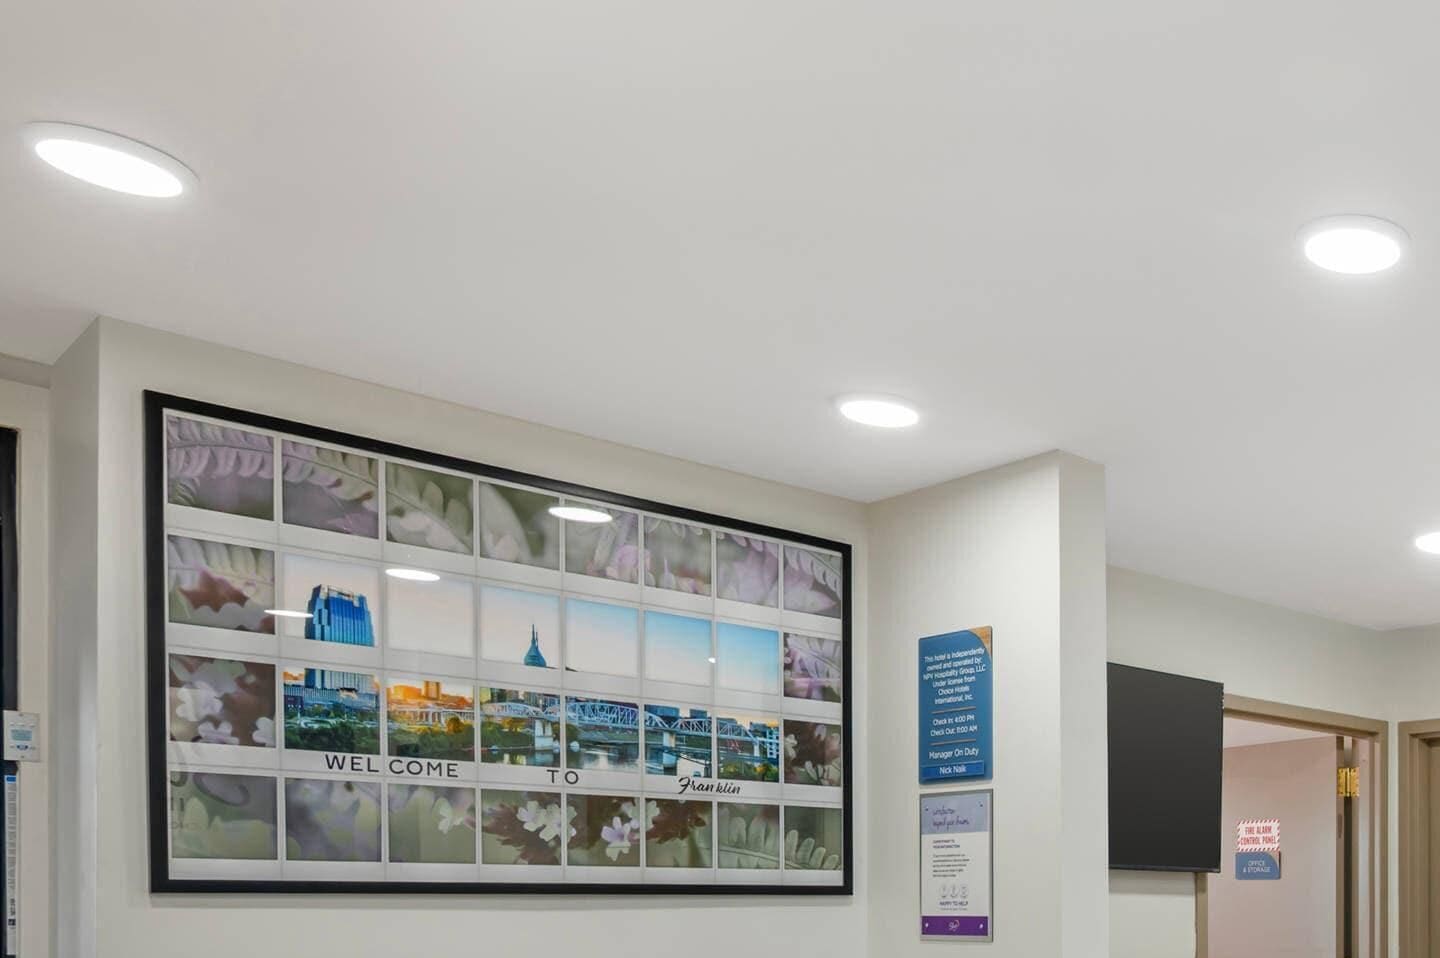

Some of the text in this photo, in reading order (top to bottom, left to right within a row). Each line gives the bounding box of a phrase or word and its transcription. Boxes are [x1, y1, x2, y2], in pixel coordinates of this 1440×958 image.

[325, 754, 742, 796] WELCOME TO Franklin
